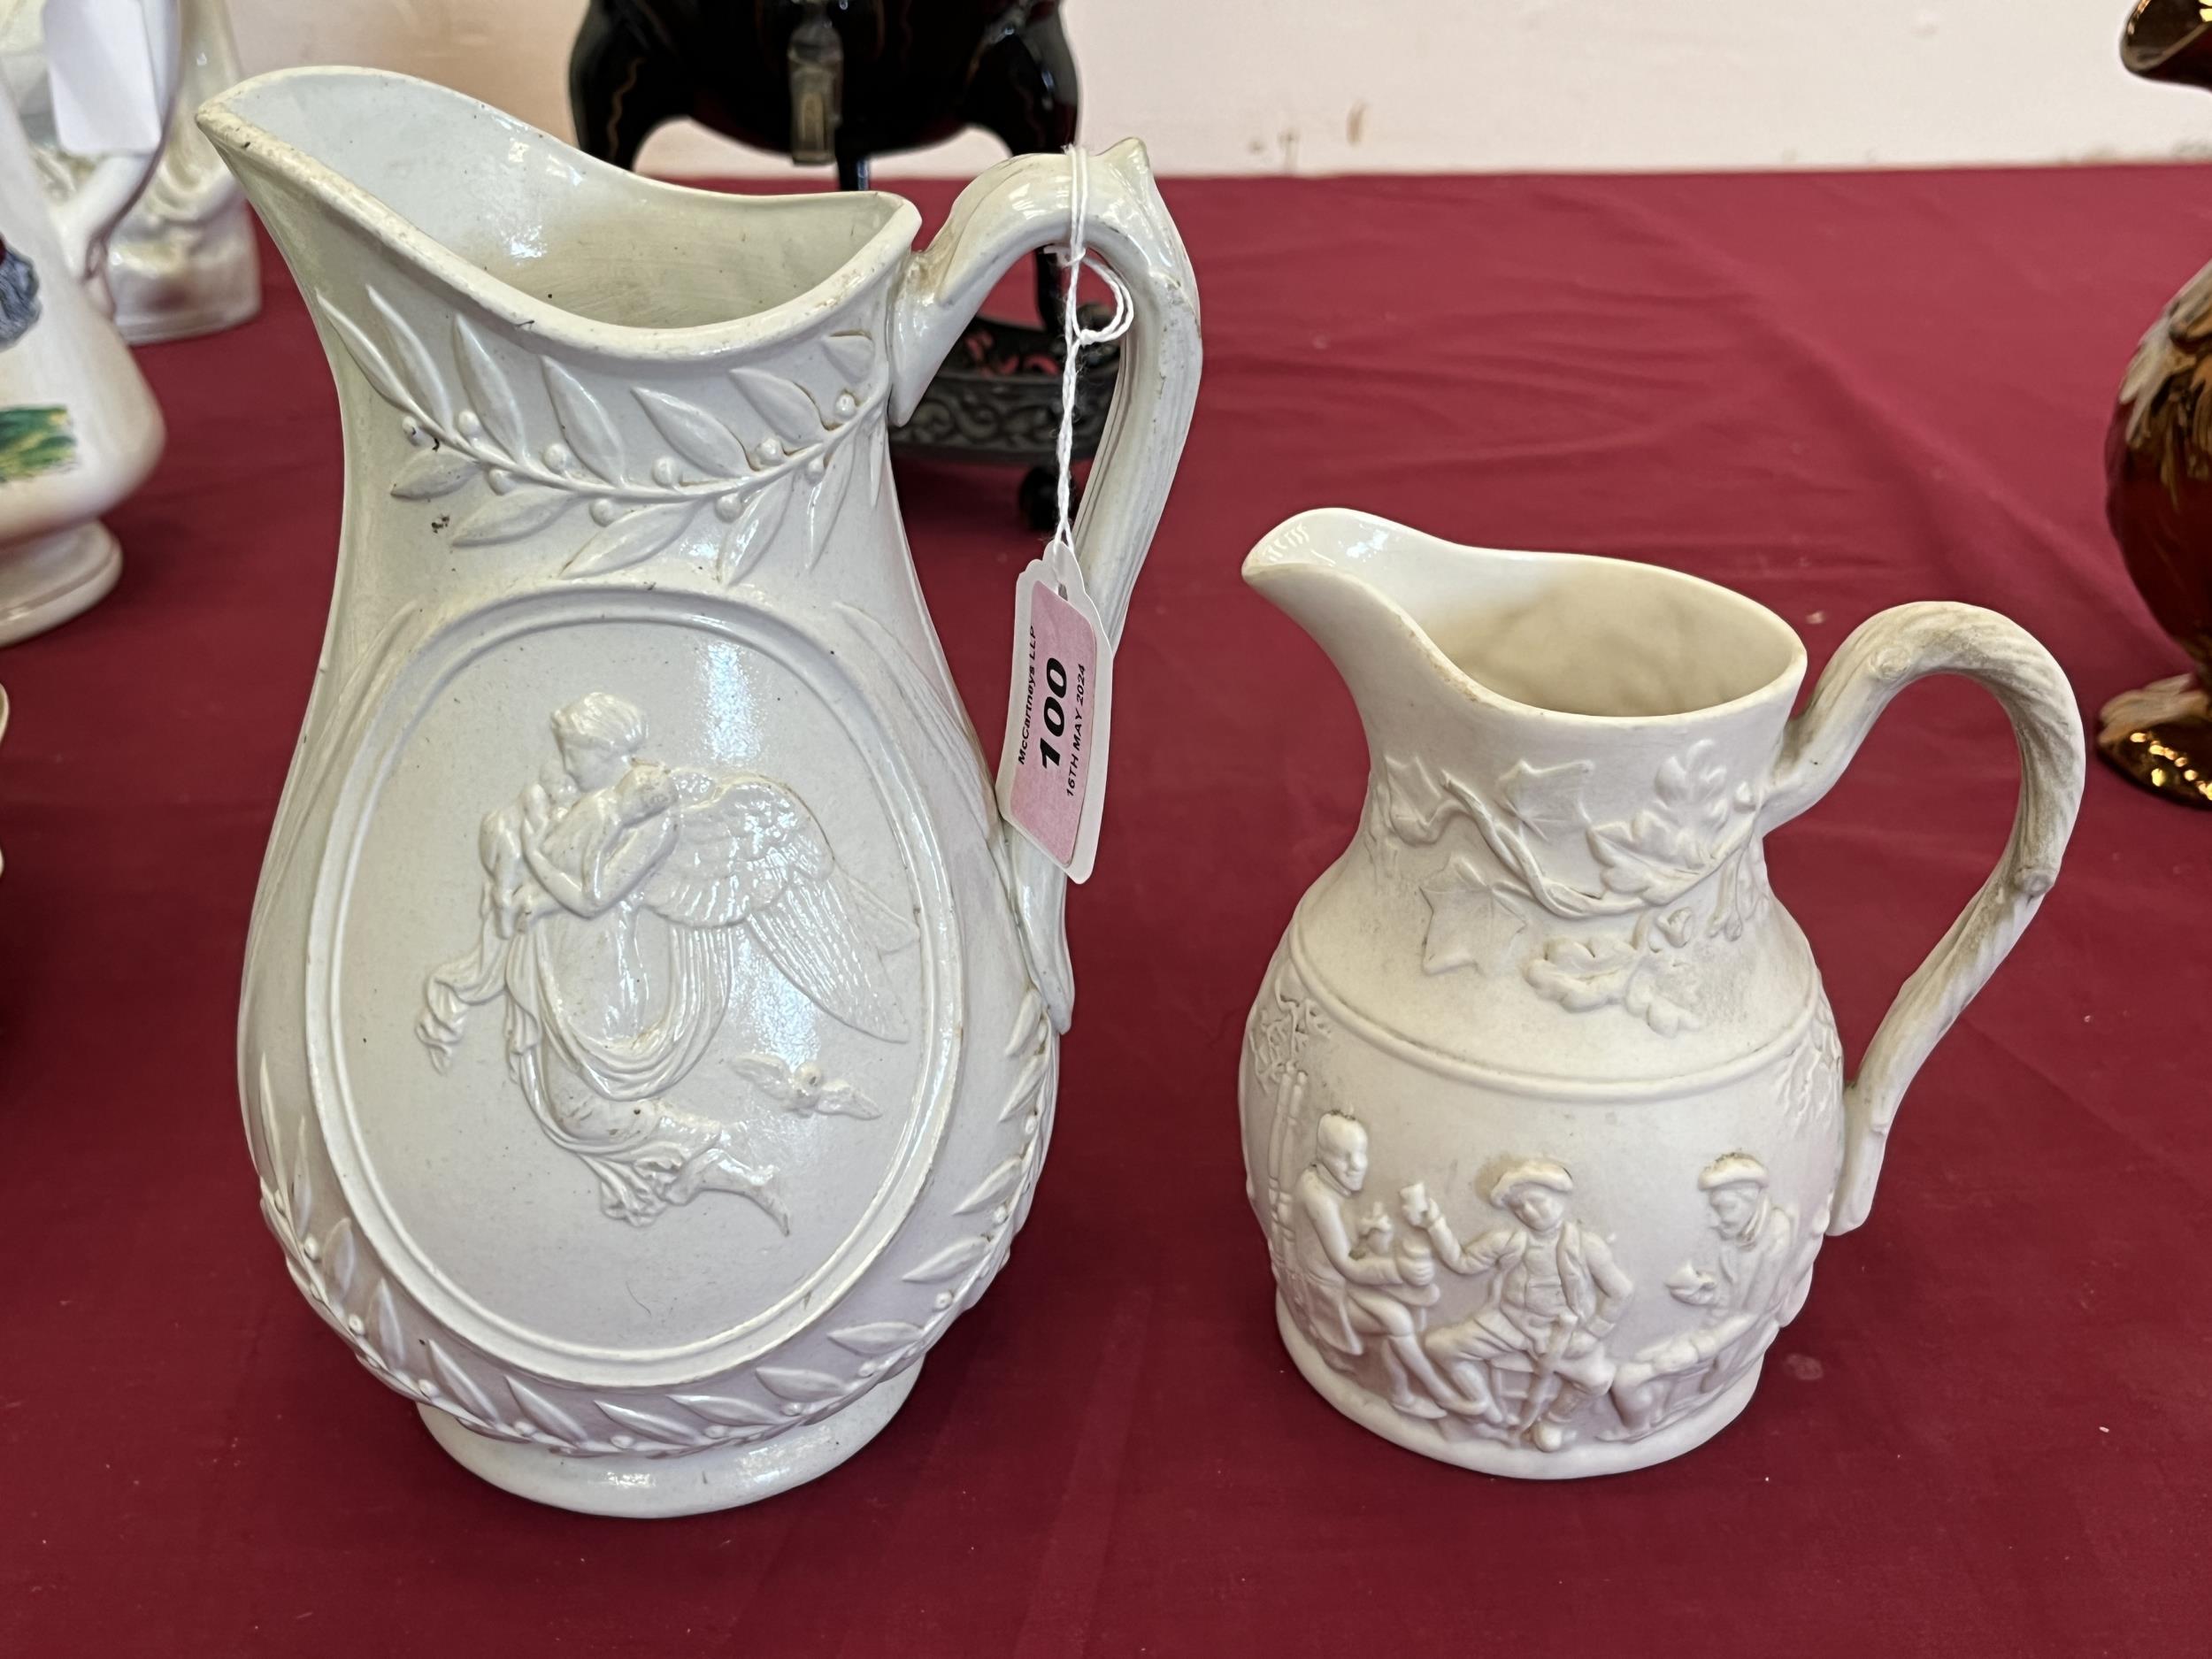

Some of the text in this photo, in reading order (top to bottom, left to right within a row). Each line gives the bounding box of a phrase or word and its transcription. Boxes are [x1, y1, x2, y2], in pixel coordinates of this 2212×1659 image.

[1018, 665, 1036, 765] McCartneys
[1040, 657, 1067, 769] 100
[1065, 664, 1086, 797] 16TH MAY 2024
